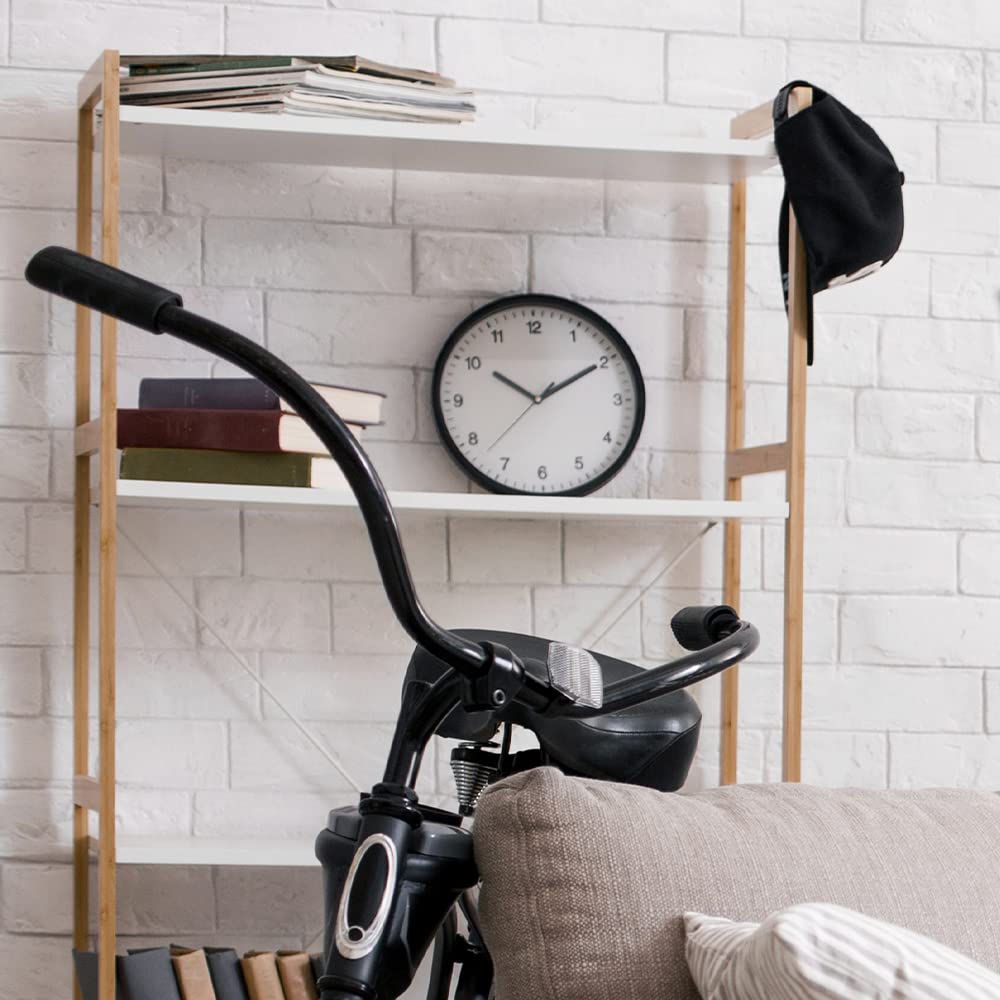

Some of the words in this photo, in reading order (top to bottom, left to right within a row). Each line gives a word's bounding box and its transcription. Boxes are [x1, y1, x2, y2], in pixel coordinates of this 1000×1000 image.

[526, 320, 542, 335] 12
[491, 329, 504, 344] 11
[569, 329, 577, 343] 1
[465, 355, 482, 370] 10
[599, 355, 609, 369] 2
[453, 393, 464, 408] 9
[613, 393, 623, 406] 3
[467, 431, 479, 446] 8
[602, 431, 613, 444] 4
[500, 457, 511, 471] 7
[574, 456, 584, 470] 5
[537, 465, 548, 480] 6
